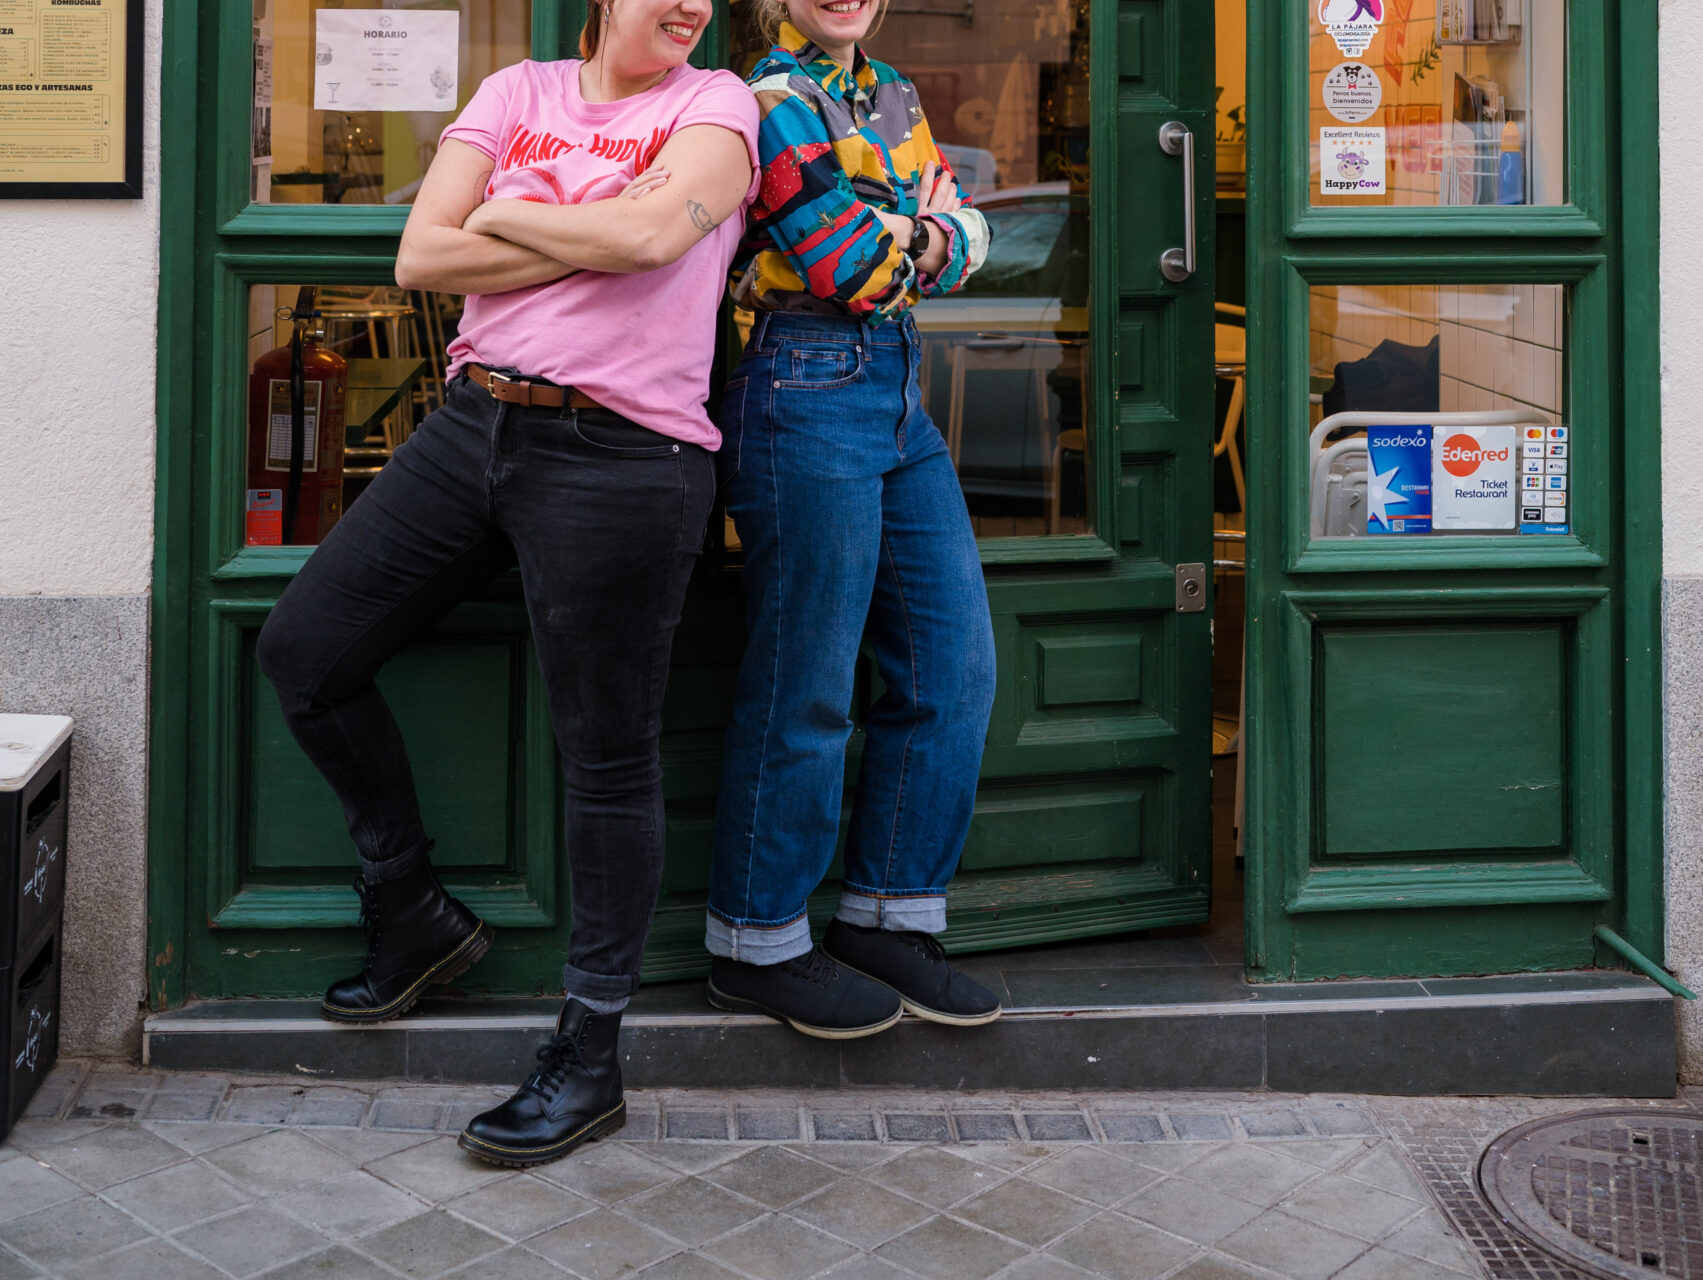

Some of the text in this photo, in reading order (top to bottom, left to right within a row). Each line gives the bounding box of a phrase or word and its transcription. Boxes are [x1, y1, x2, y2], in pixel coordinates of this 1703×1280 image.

[0, 27, 14, 35] ZA
[364, 30, 408, 39] HORARIO
[1372, 433, 1427, 448] sodexo
[1441, 446, 1509, 462] Edenred
[1480, 480, 1508, 489] Ticket
[1455, 489, 1508, 499] Restaurant
